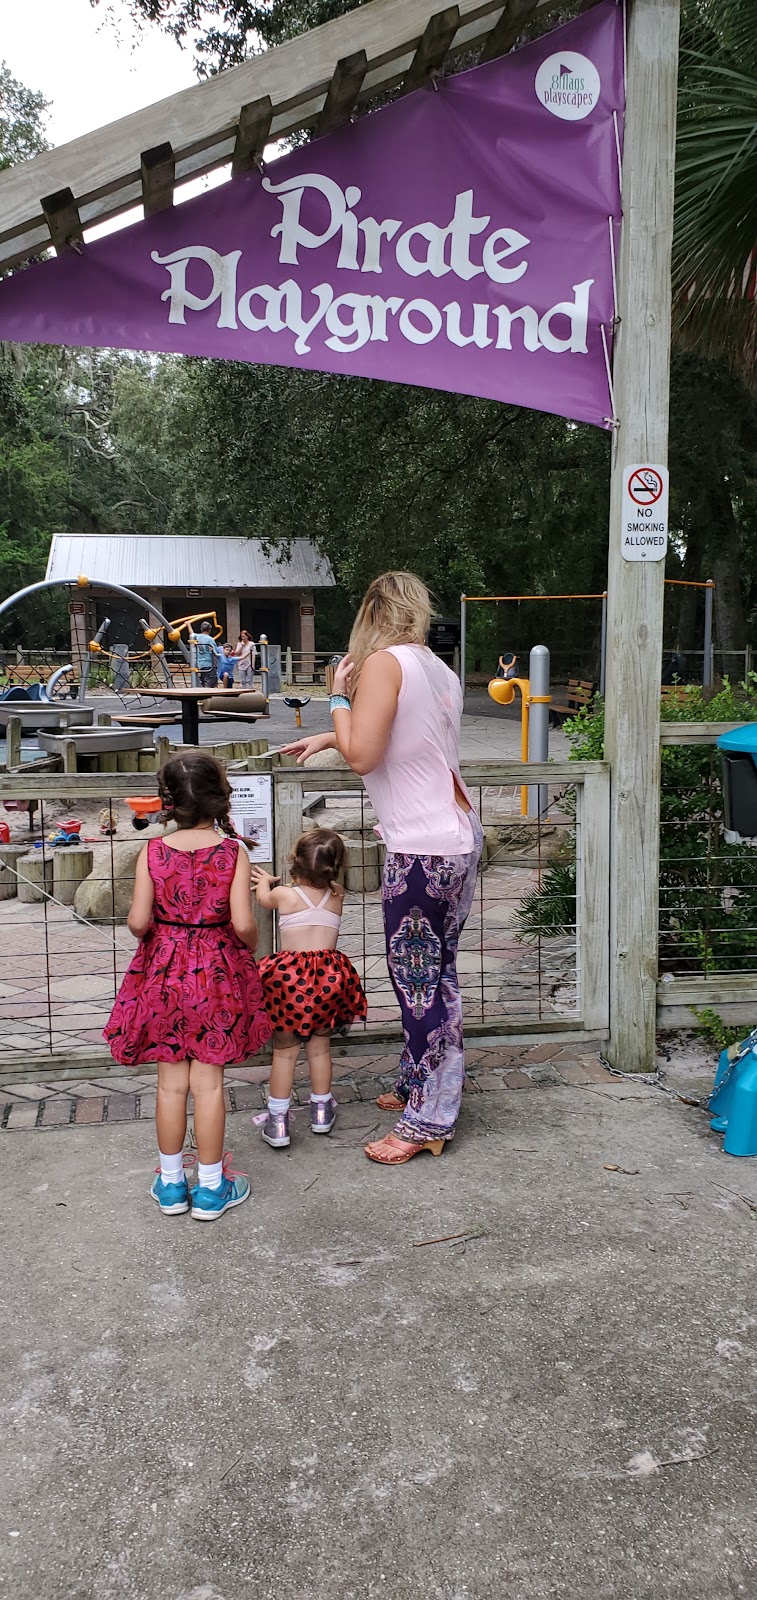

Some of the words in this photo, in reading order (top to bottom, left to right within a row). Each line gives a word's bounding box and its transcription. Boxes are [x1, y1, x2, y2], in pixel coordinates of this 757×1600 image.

[552, 75, 559, 90] 8
[562, 74, 585, 93] flags
[544, 87, 593, 108] playscapes
[261, 173, 531, 284] Pirate
[150, 245, 595, 355] Playground
[637, 508, 652, 517] NO
[627, 523, 664, 532] SMOKING
[625, 537, 664, 545] ALLOWED
